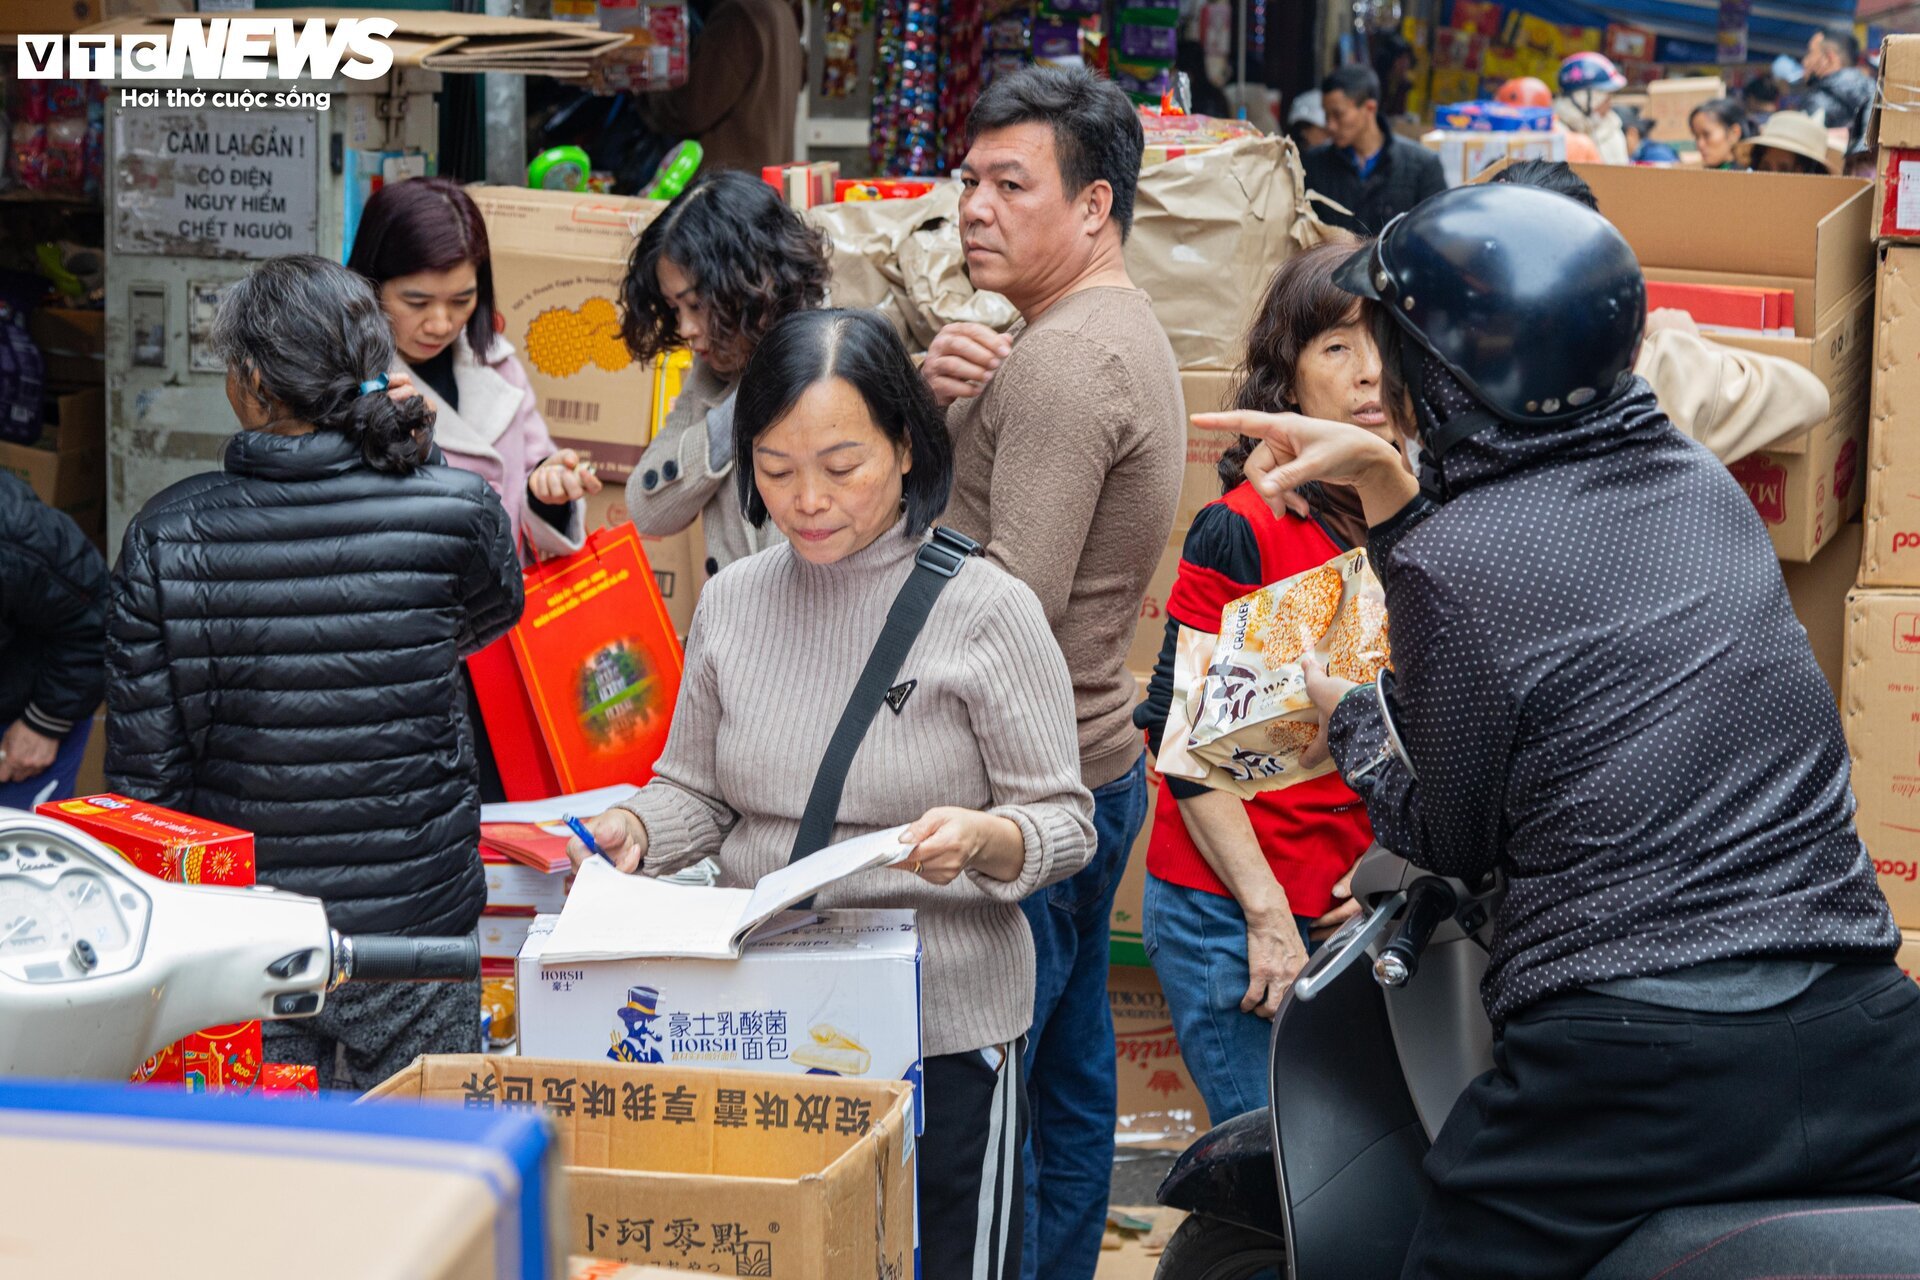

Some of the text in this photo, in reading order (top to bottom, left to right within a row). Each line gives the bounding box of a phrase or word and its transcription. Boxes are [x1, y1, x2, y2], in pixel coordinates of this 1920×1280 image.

[230, 166, 273, 190] ĐIỆN
[185, 190, 287, 213] NGUY HIỂM
[178, 216, 293, 240] CHẾT NGƯỜI
[541, 970, 583, 980] HORSH
[669, 1010, 788, 1038] 豪士乳酸菌
[671, 1038, 737, 1053] HORSH
[741, 1037, 789, 1061] 面包
[713, 1088, 872, 1137] 绽放味蕾
